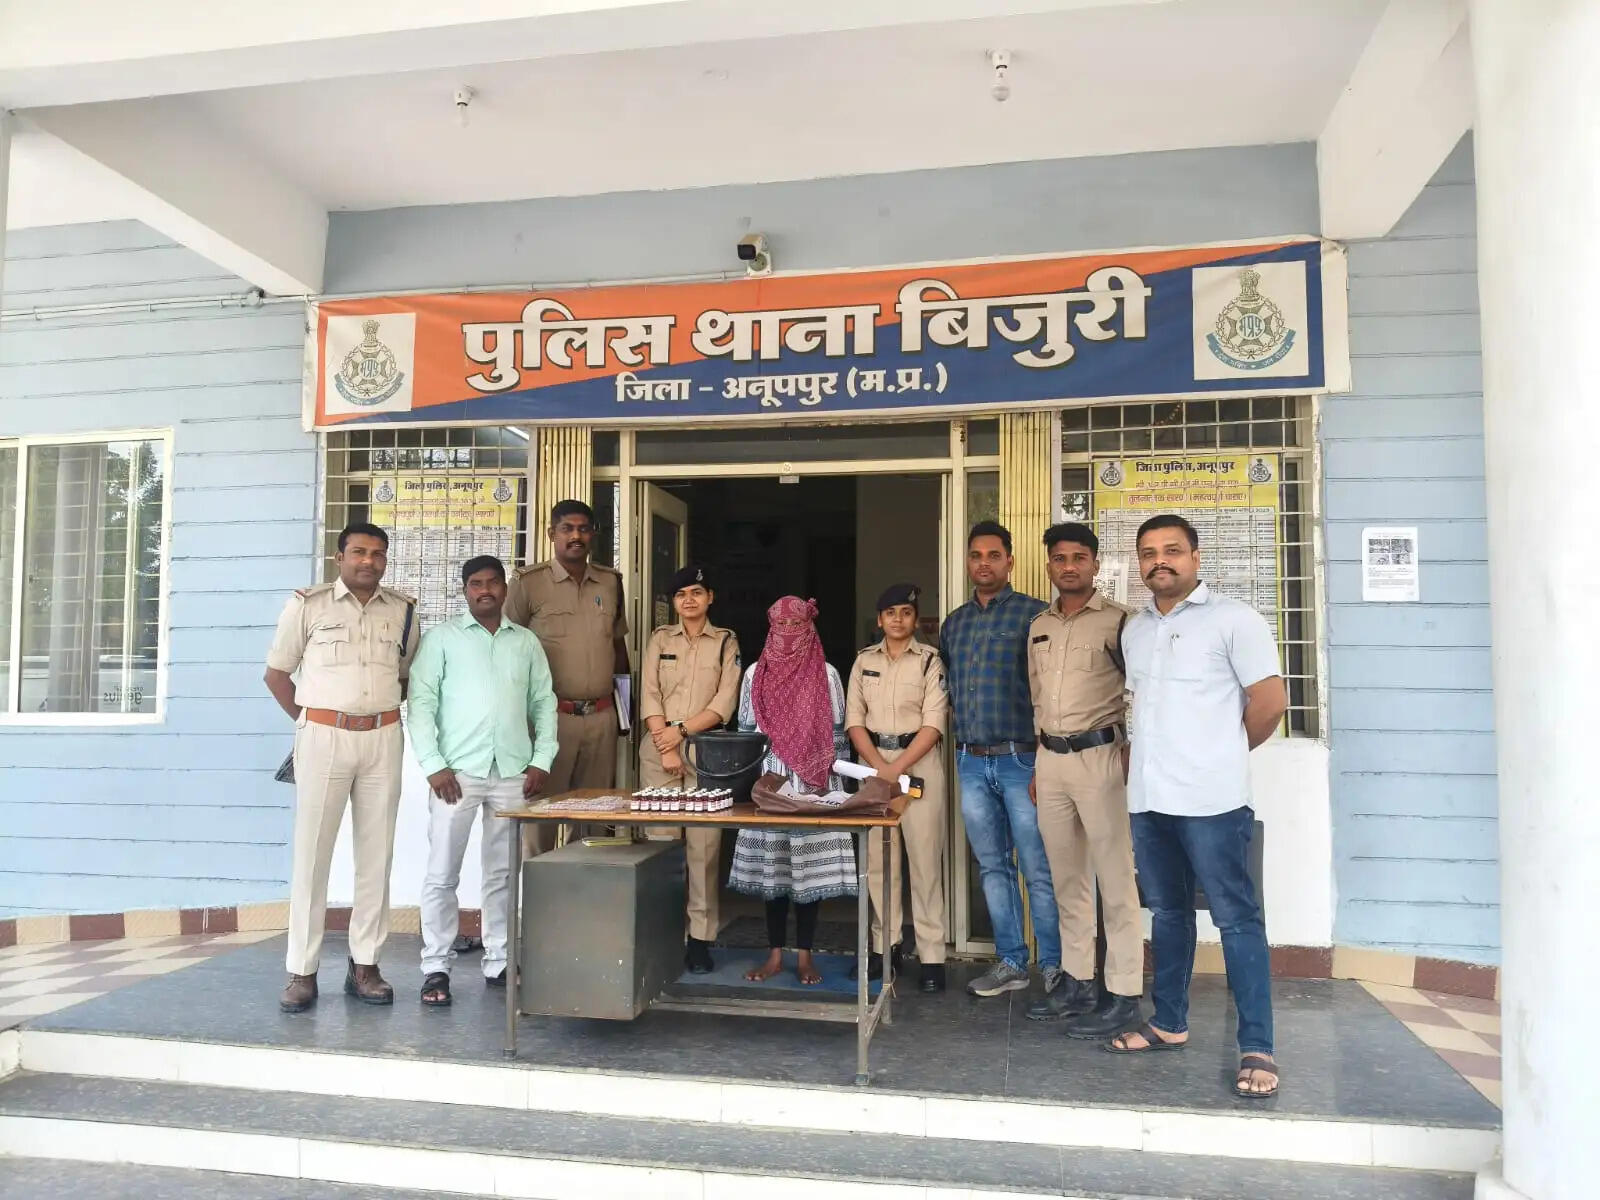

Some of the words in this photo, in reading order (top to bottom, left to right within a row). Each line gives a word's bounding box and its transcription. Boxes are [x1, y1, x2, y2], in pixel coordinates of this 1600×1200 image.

[462, 298, 677, 392] पुलिस
[690, 304, 881, 362] थाना
[895, 265, 1153, 369] बिजुरी
[616, 371, 692, 402] जिला
[721, 372, 839, 407] अनूपपुर
[846, 362, 949, 399] (म.प्र.)
